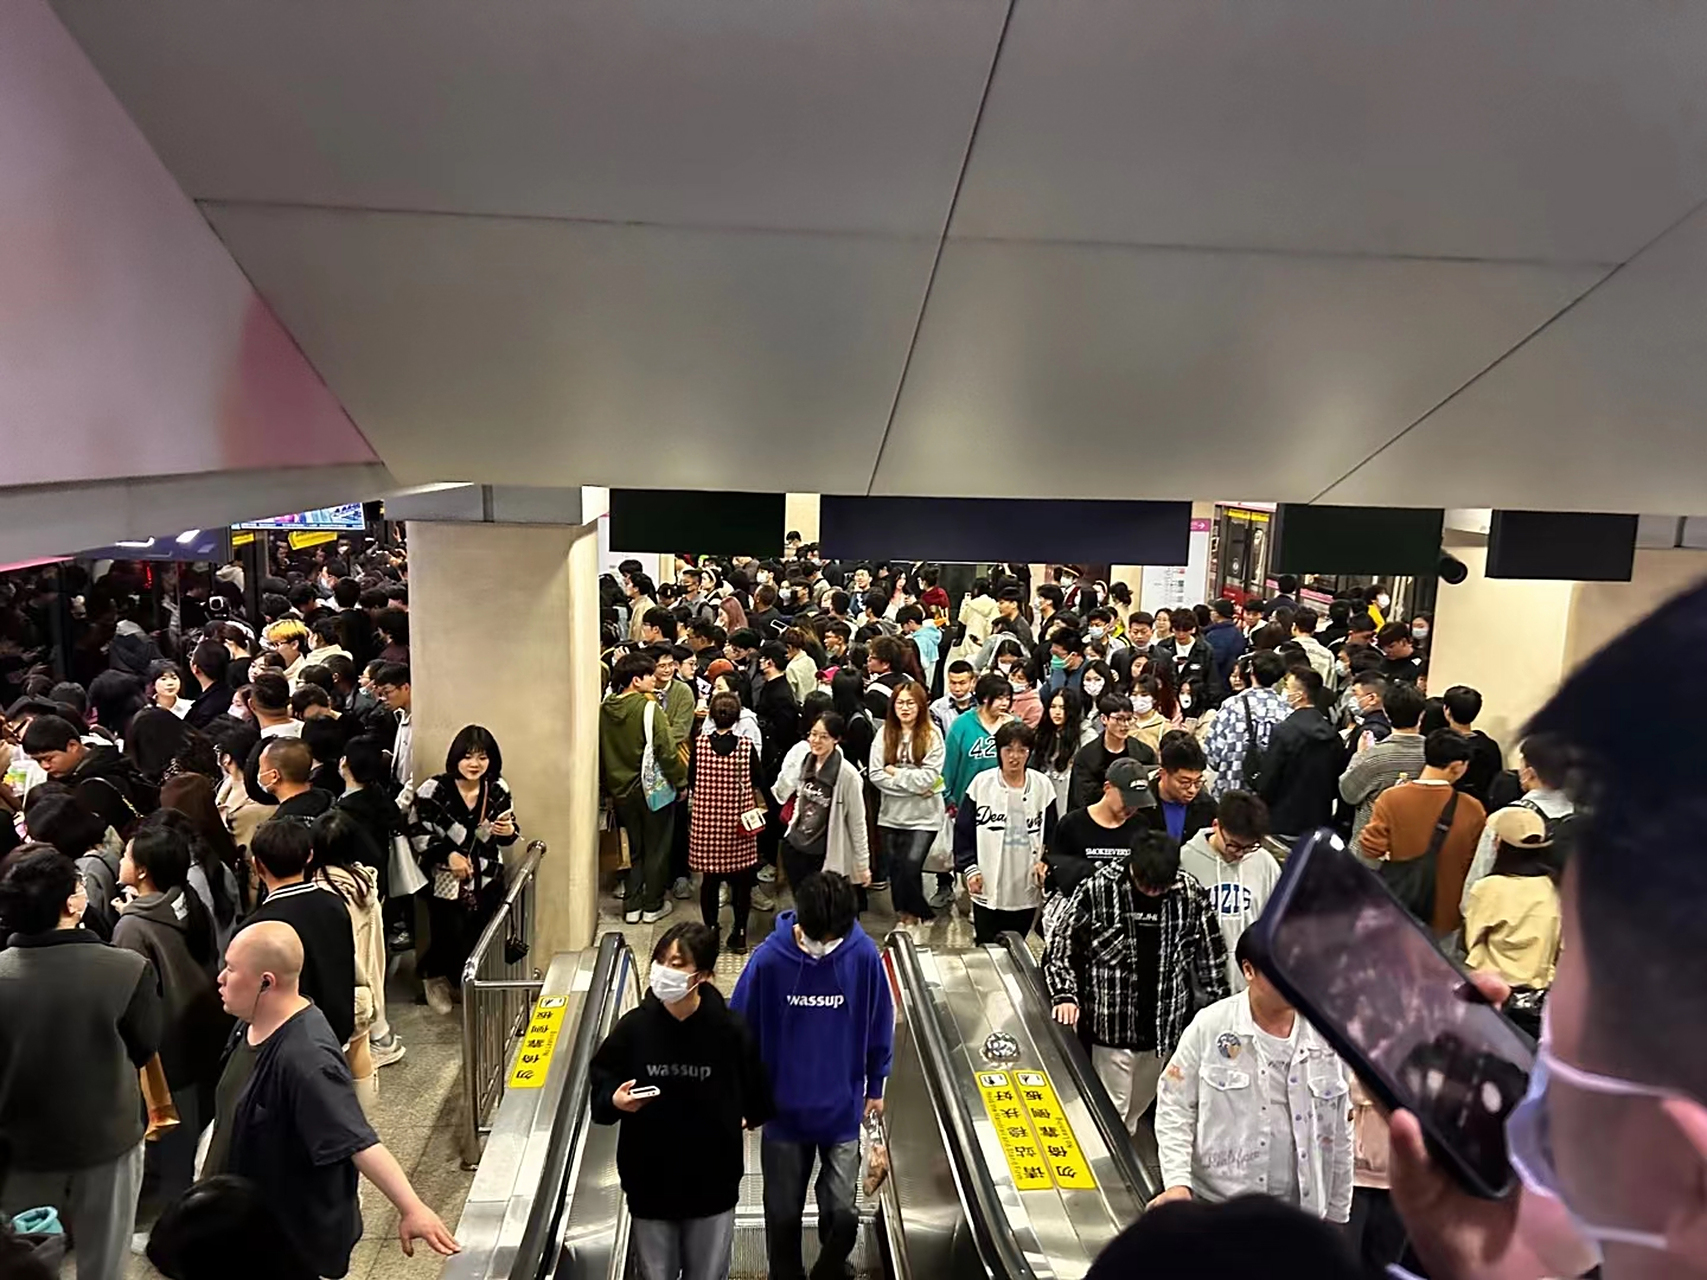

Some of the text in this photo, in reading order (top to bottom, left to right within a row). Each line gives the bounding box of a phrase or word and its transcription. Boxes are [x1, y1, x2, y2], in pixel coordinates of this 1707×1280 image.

[786, 994, 845, 1009] wassup
[646, 1063, 712, 1081] wassup
[994, 1090, 1045, 1179] 请站稳扶好
[1023, 1090, 1077, 1179] 勿倚靠侧板
